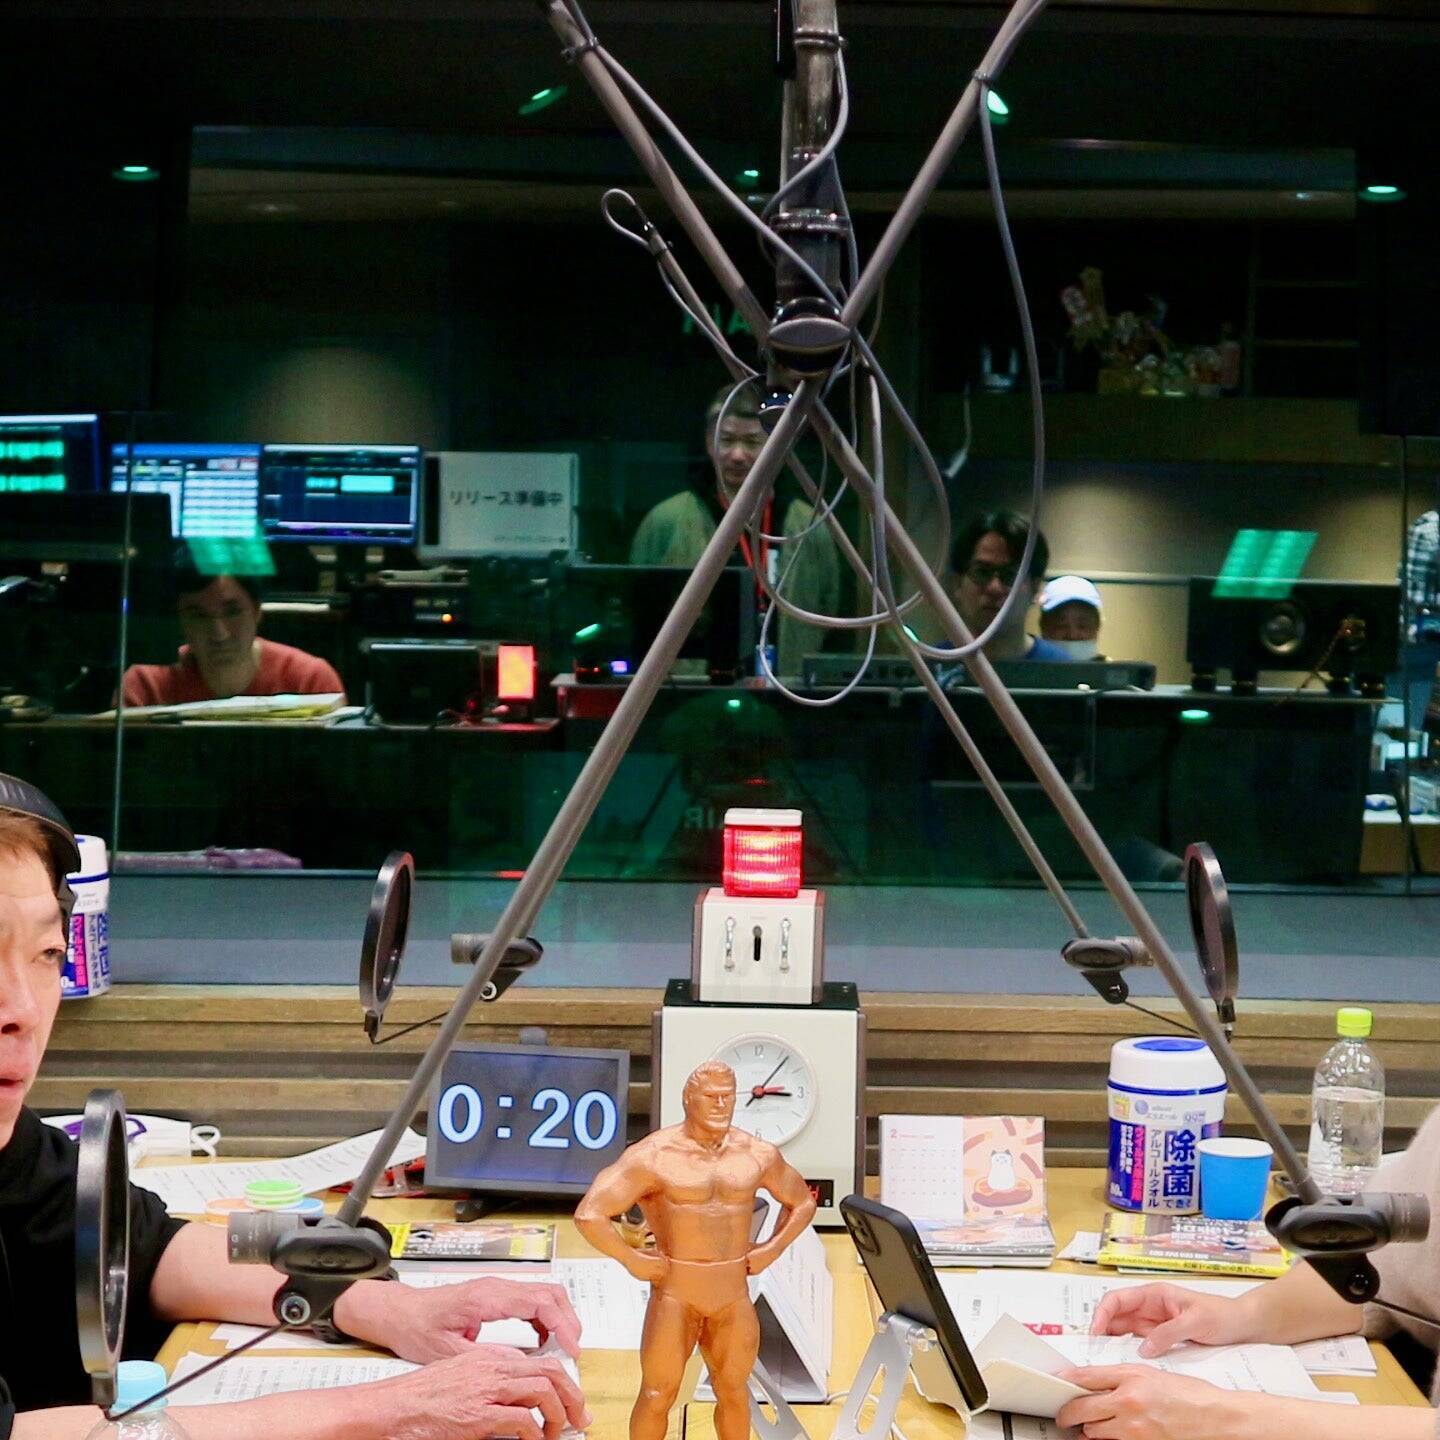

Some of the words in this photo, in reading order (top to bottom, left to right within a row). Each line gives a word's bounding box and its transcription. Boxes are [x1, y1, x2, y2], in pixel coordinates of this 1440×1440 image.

[754, 1045, 764, 1056] 12
[797, 1086, 805, 1099] 3
[438, 1084, 618, 1150] 0:20
[890, 1129, 898, 1139] 2
[1148, 1129, 1162, 1208] アルコールタオル
[1163, 1129, 1196, 1197] 除菌
